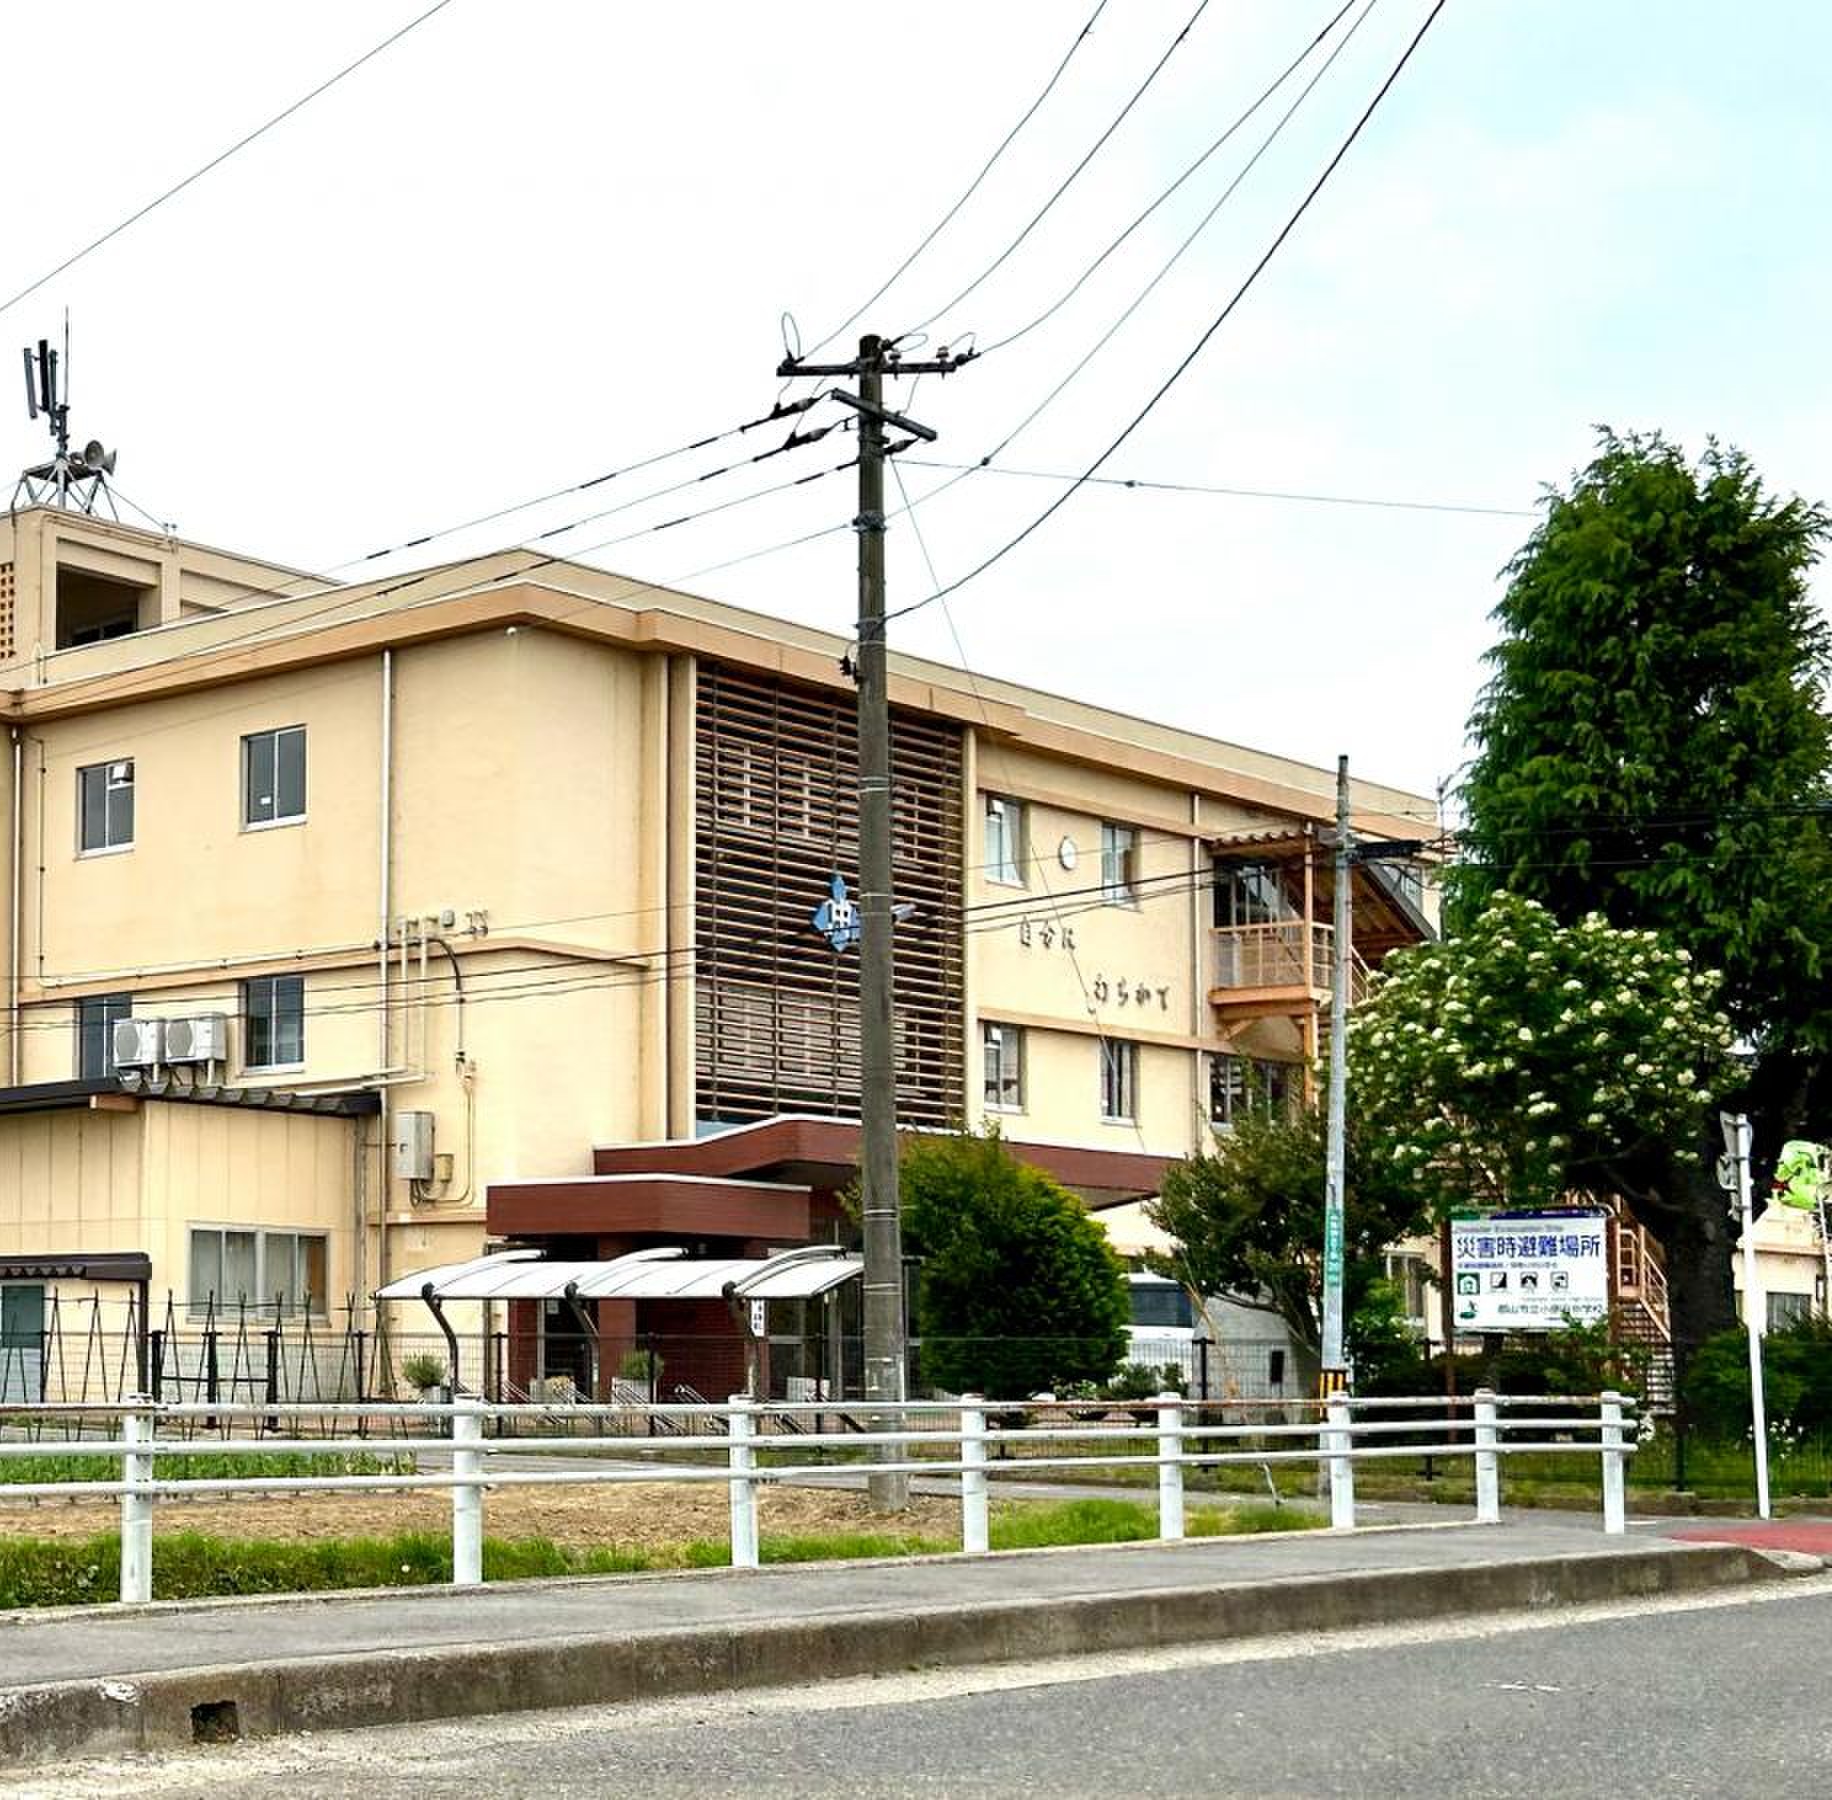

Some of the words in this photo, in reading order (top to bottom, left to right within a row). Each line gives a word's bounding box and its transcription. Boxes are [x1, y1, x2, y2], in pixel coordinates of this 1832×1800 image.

[1457, 1234, 1601, 1258] 災害時避難場所
